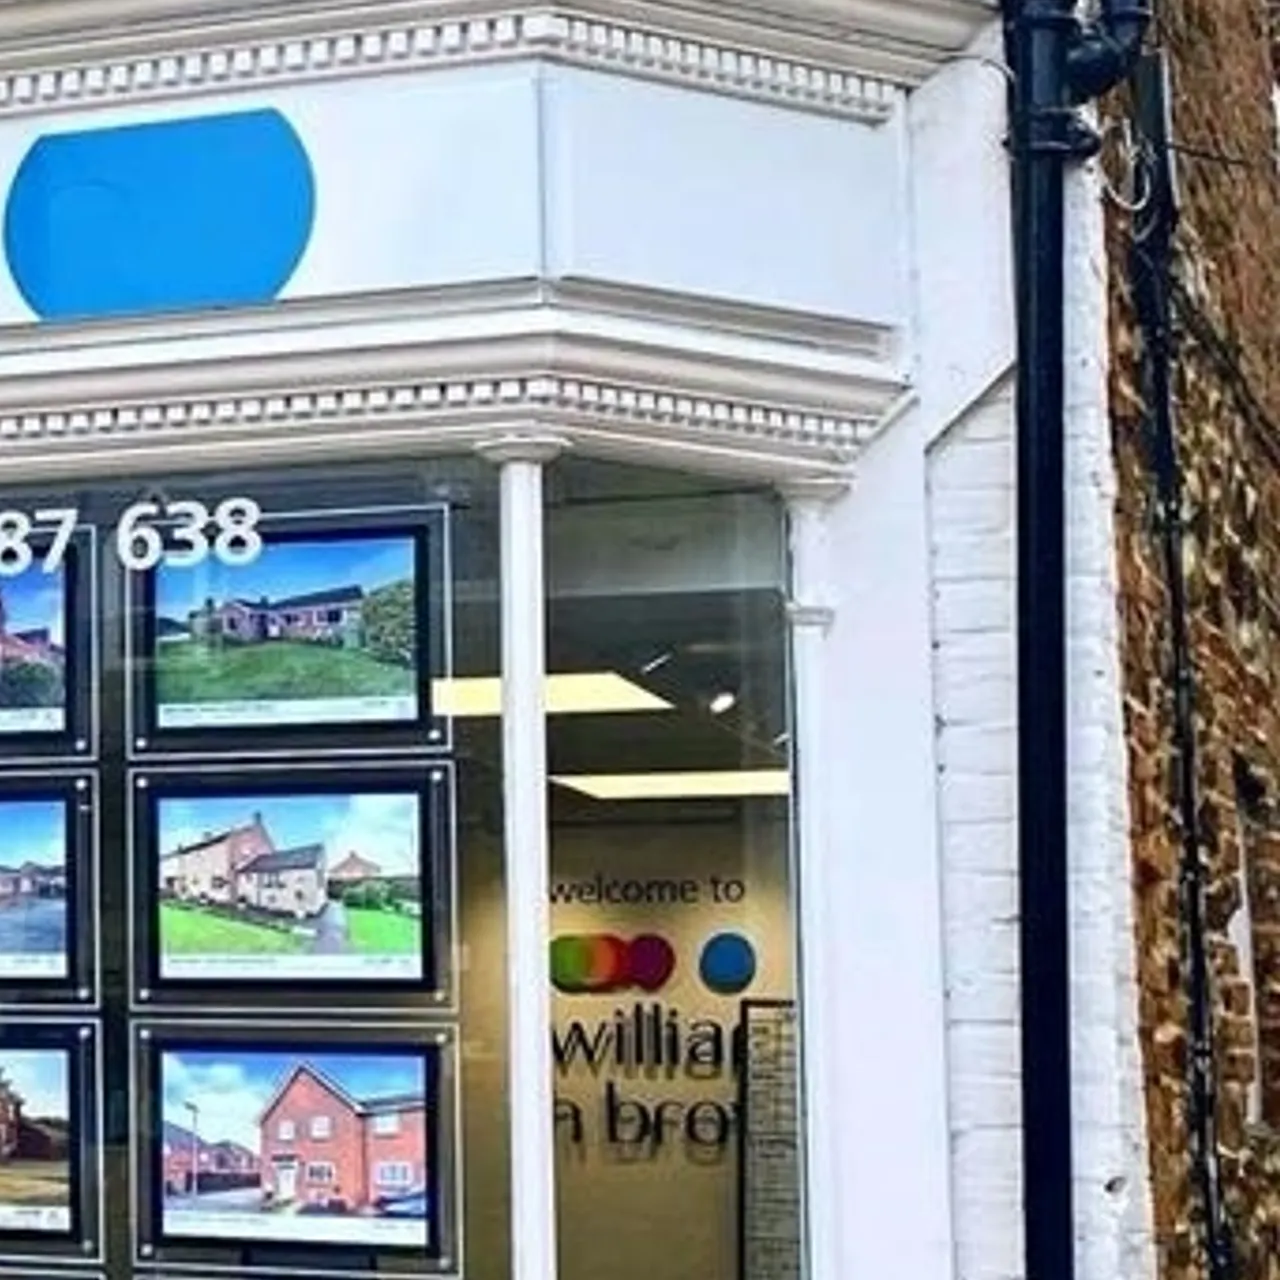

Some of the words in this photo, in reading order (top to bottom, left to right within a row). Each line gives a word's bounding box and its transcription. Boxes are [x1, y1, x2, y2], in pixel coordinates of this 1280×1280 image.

[117, 498, 262, 571] 638
[551, 876, 698, 904] welcome
[710, 876, 745, 903] to
